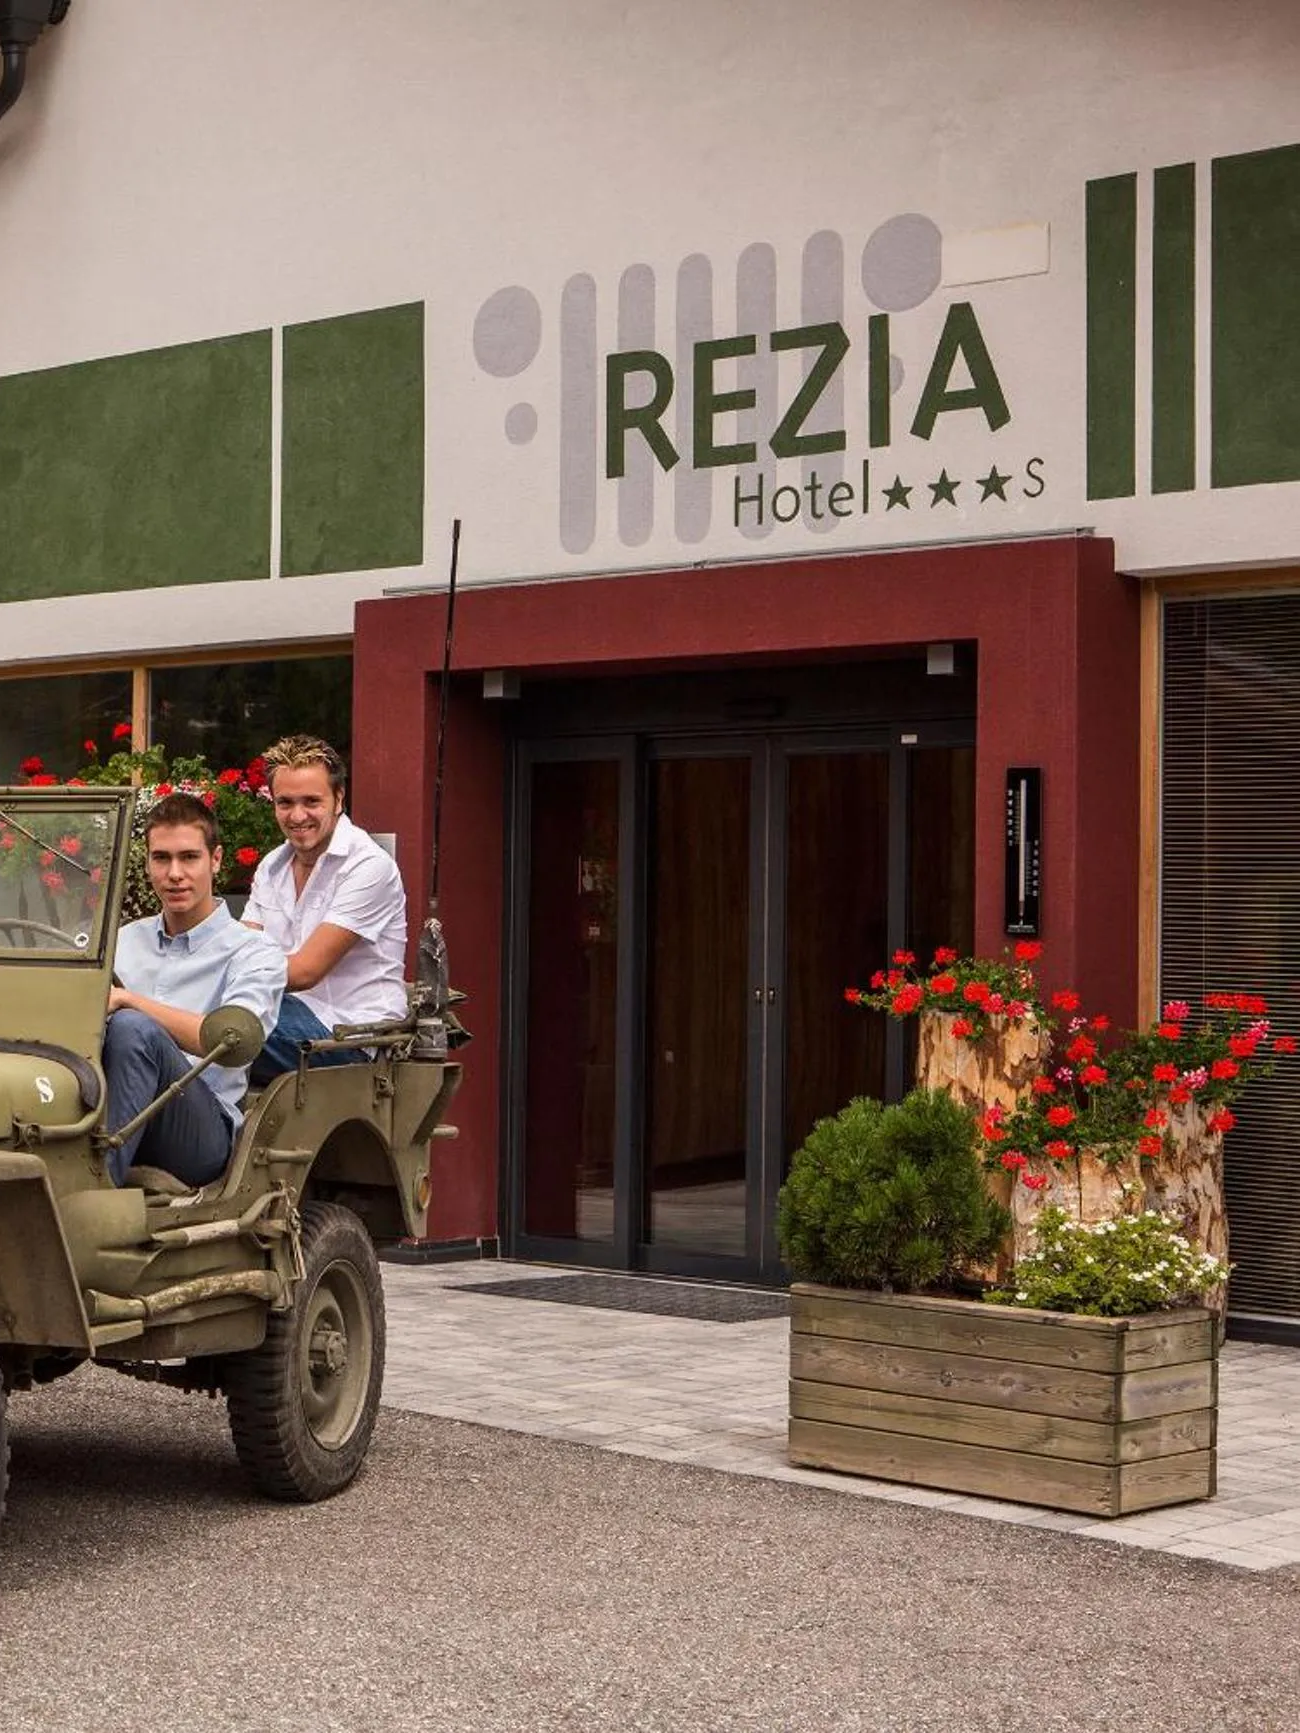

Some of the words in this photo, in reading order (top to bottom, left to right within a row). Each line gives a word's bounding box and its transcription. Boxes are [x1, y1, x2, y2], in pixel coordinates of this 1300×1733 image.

[606, 302, 1012, 479] REZIA
[734, 459, 870, 527] Hotel
[35, 1076, 55, 1103] S
